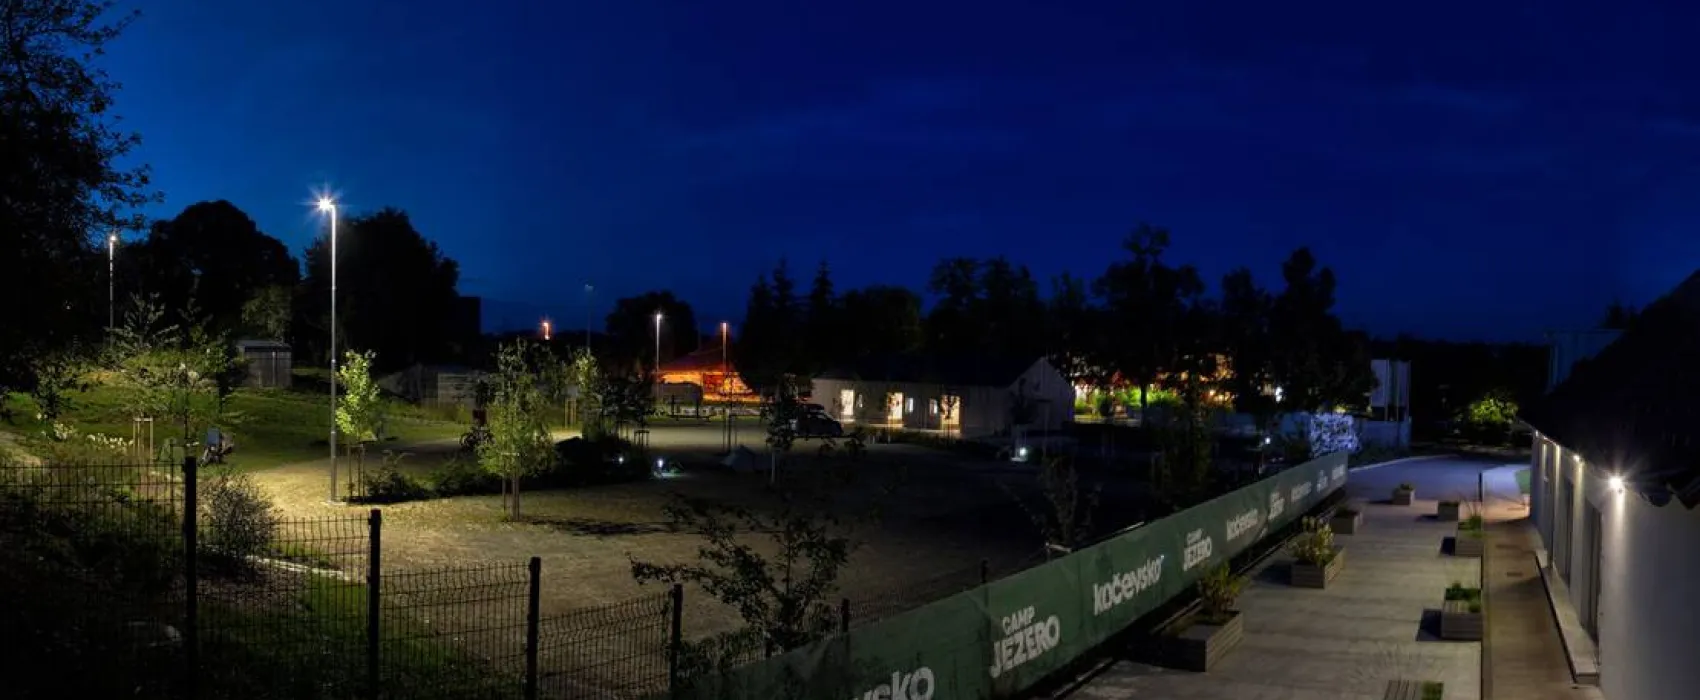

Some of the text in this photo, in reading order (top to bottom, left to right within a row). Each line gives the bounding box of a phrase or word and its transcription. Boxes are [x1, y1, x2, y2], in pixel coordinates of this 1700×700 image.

[1093, 556, 1163, 616] kočevsko
[989, 614, 1061, 678] JEZERO
[1002, 605, 1035, 636] CAMP
